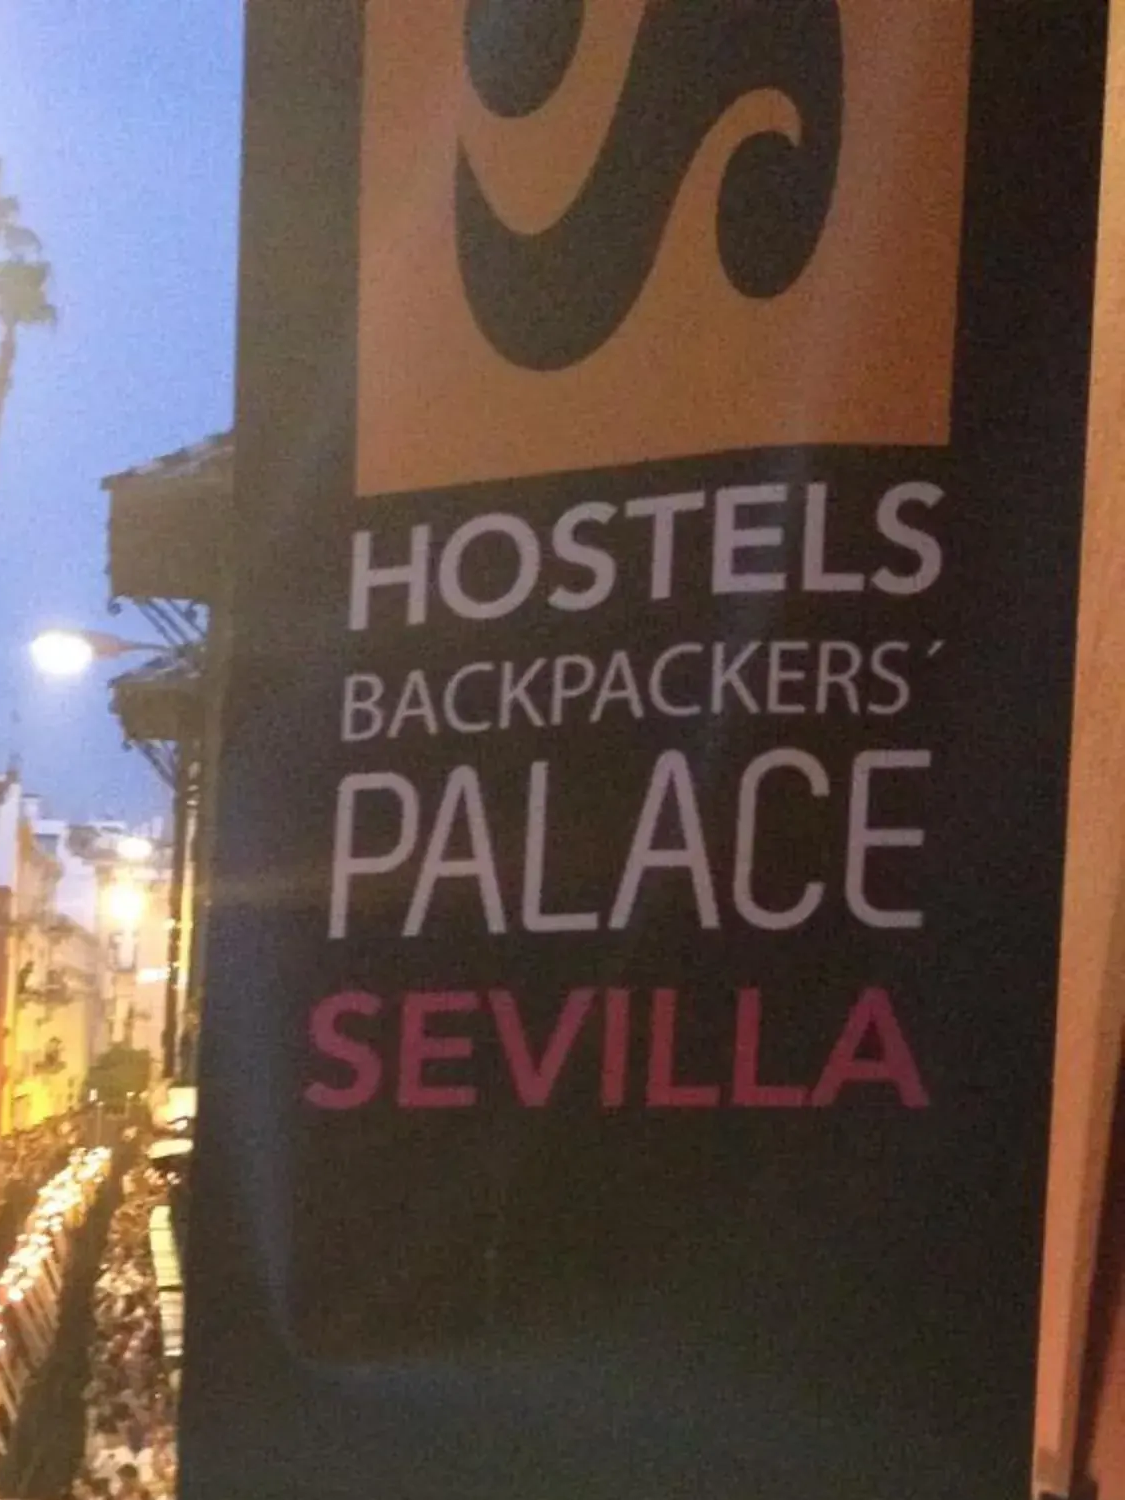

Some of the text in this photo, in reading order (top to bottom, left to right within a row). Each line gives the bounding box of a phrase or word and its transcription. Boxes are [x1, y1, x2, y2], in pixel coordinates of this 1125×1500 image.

[348, 481, 946, 632] HOSTELS
[328, 748, 932, 940] PALACE
[305, 986, 930, 1110] SEVILLA
